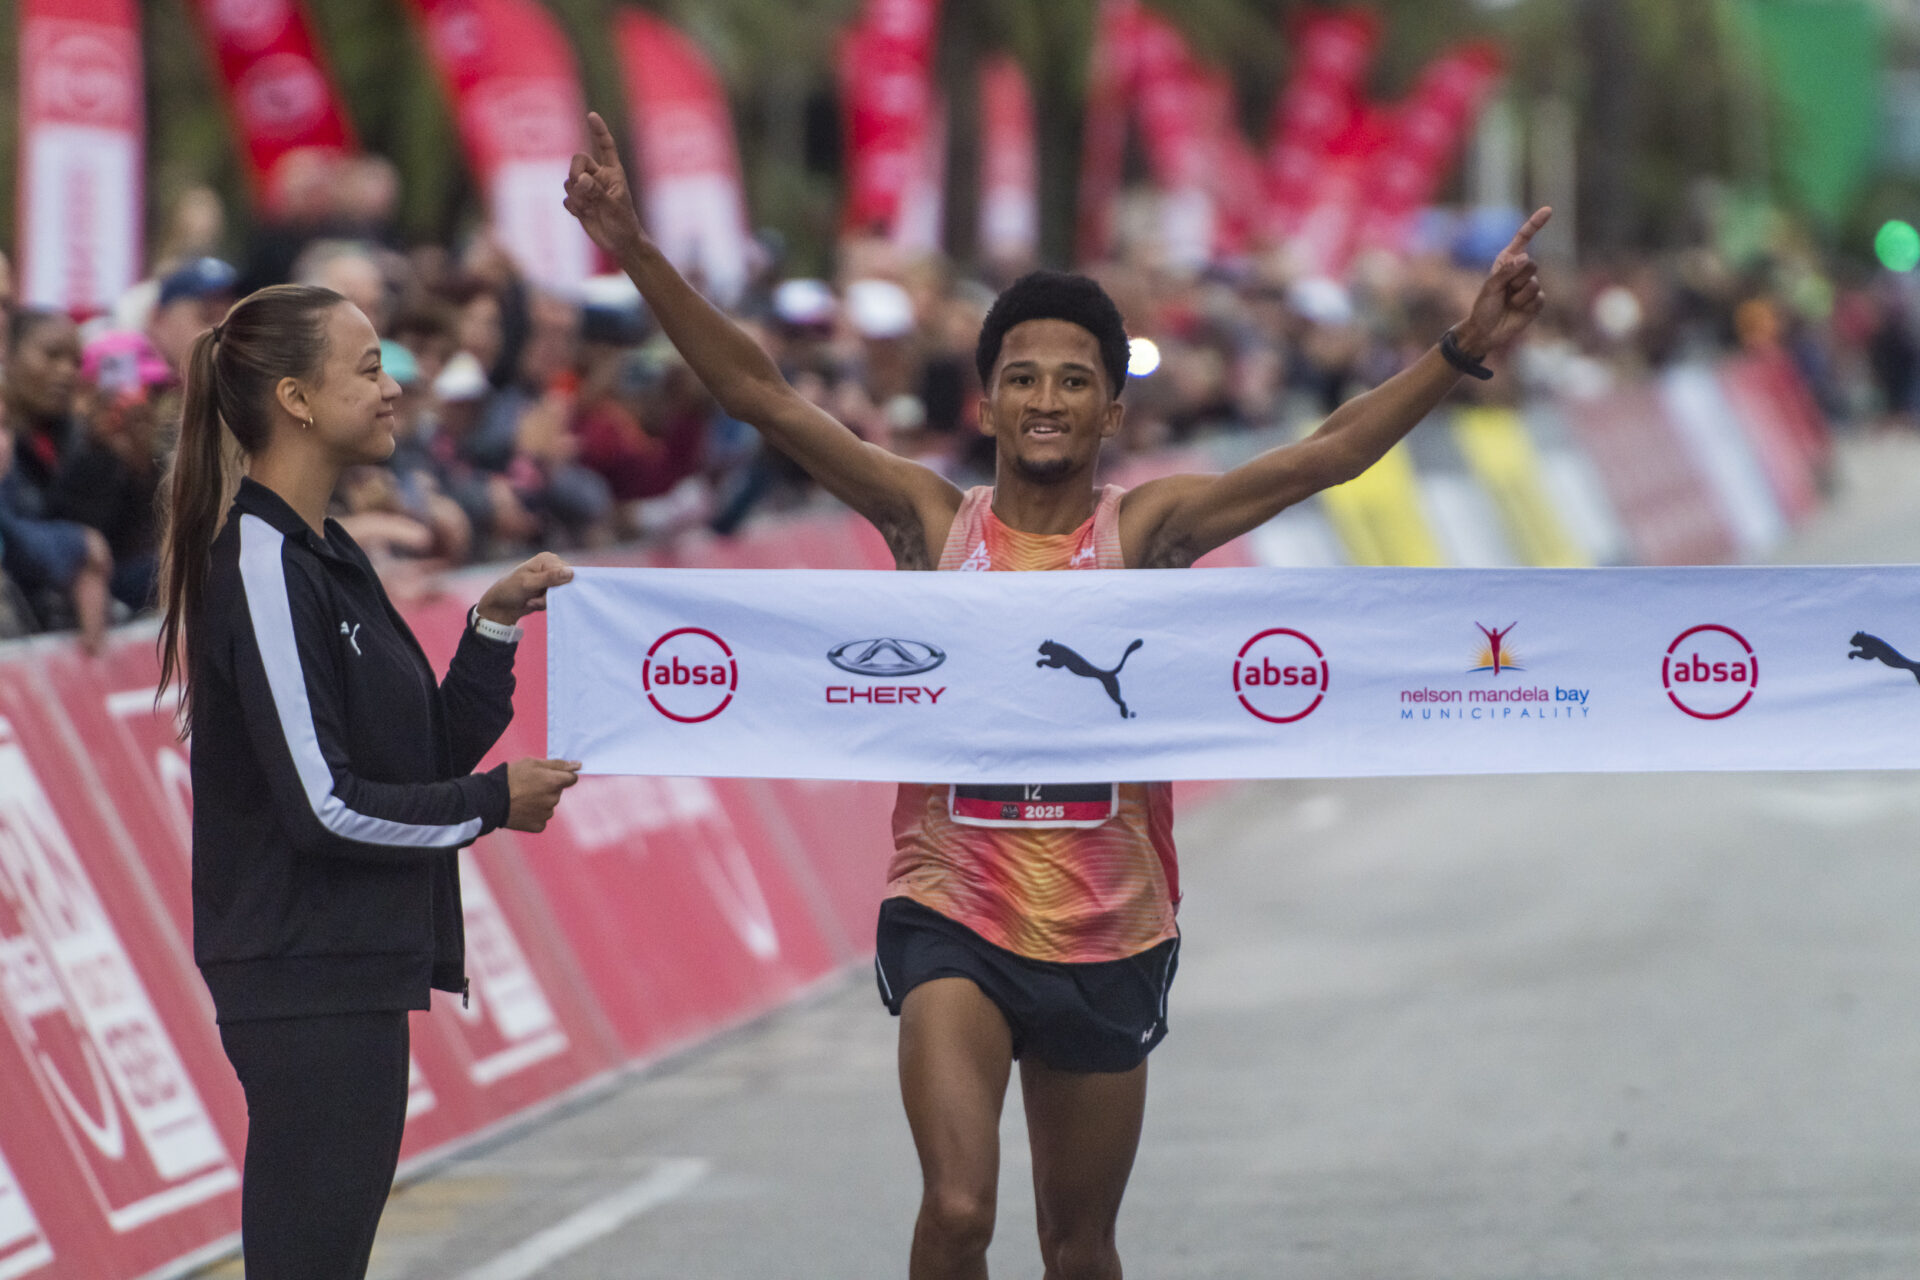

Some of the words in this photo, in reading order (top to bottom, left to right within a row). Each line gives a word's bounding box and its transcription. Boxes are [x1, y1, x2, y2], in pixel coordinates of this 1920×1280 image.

[654, 655, 727, 686] absa
[1244, 656, 1318, 686] absa
[1673, 652, 1747, 682] absa
[826, 686, 947, 704] CHERY
[1400, 687, 1462, 703] nelson
[1468, 686, 1550, 703] mandela
[1555, 685, 1590, 705] bay
[1400, 707, 1590, 720] MUNICIPALITY
[1025, 805, 1065, 819] 2025
